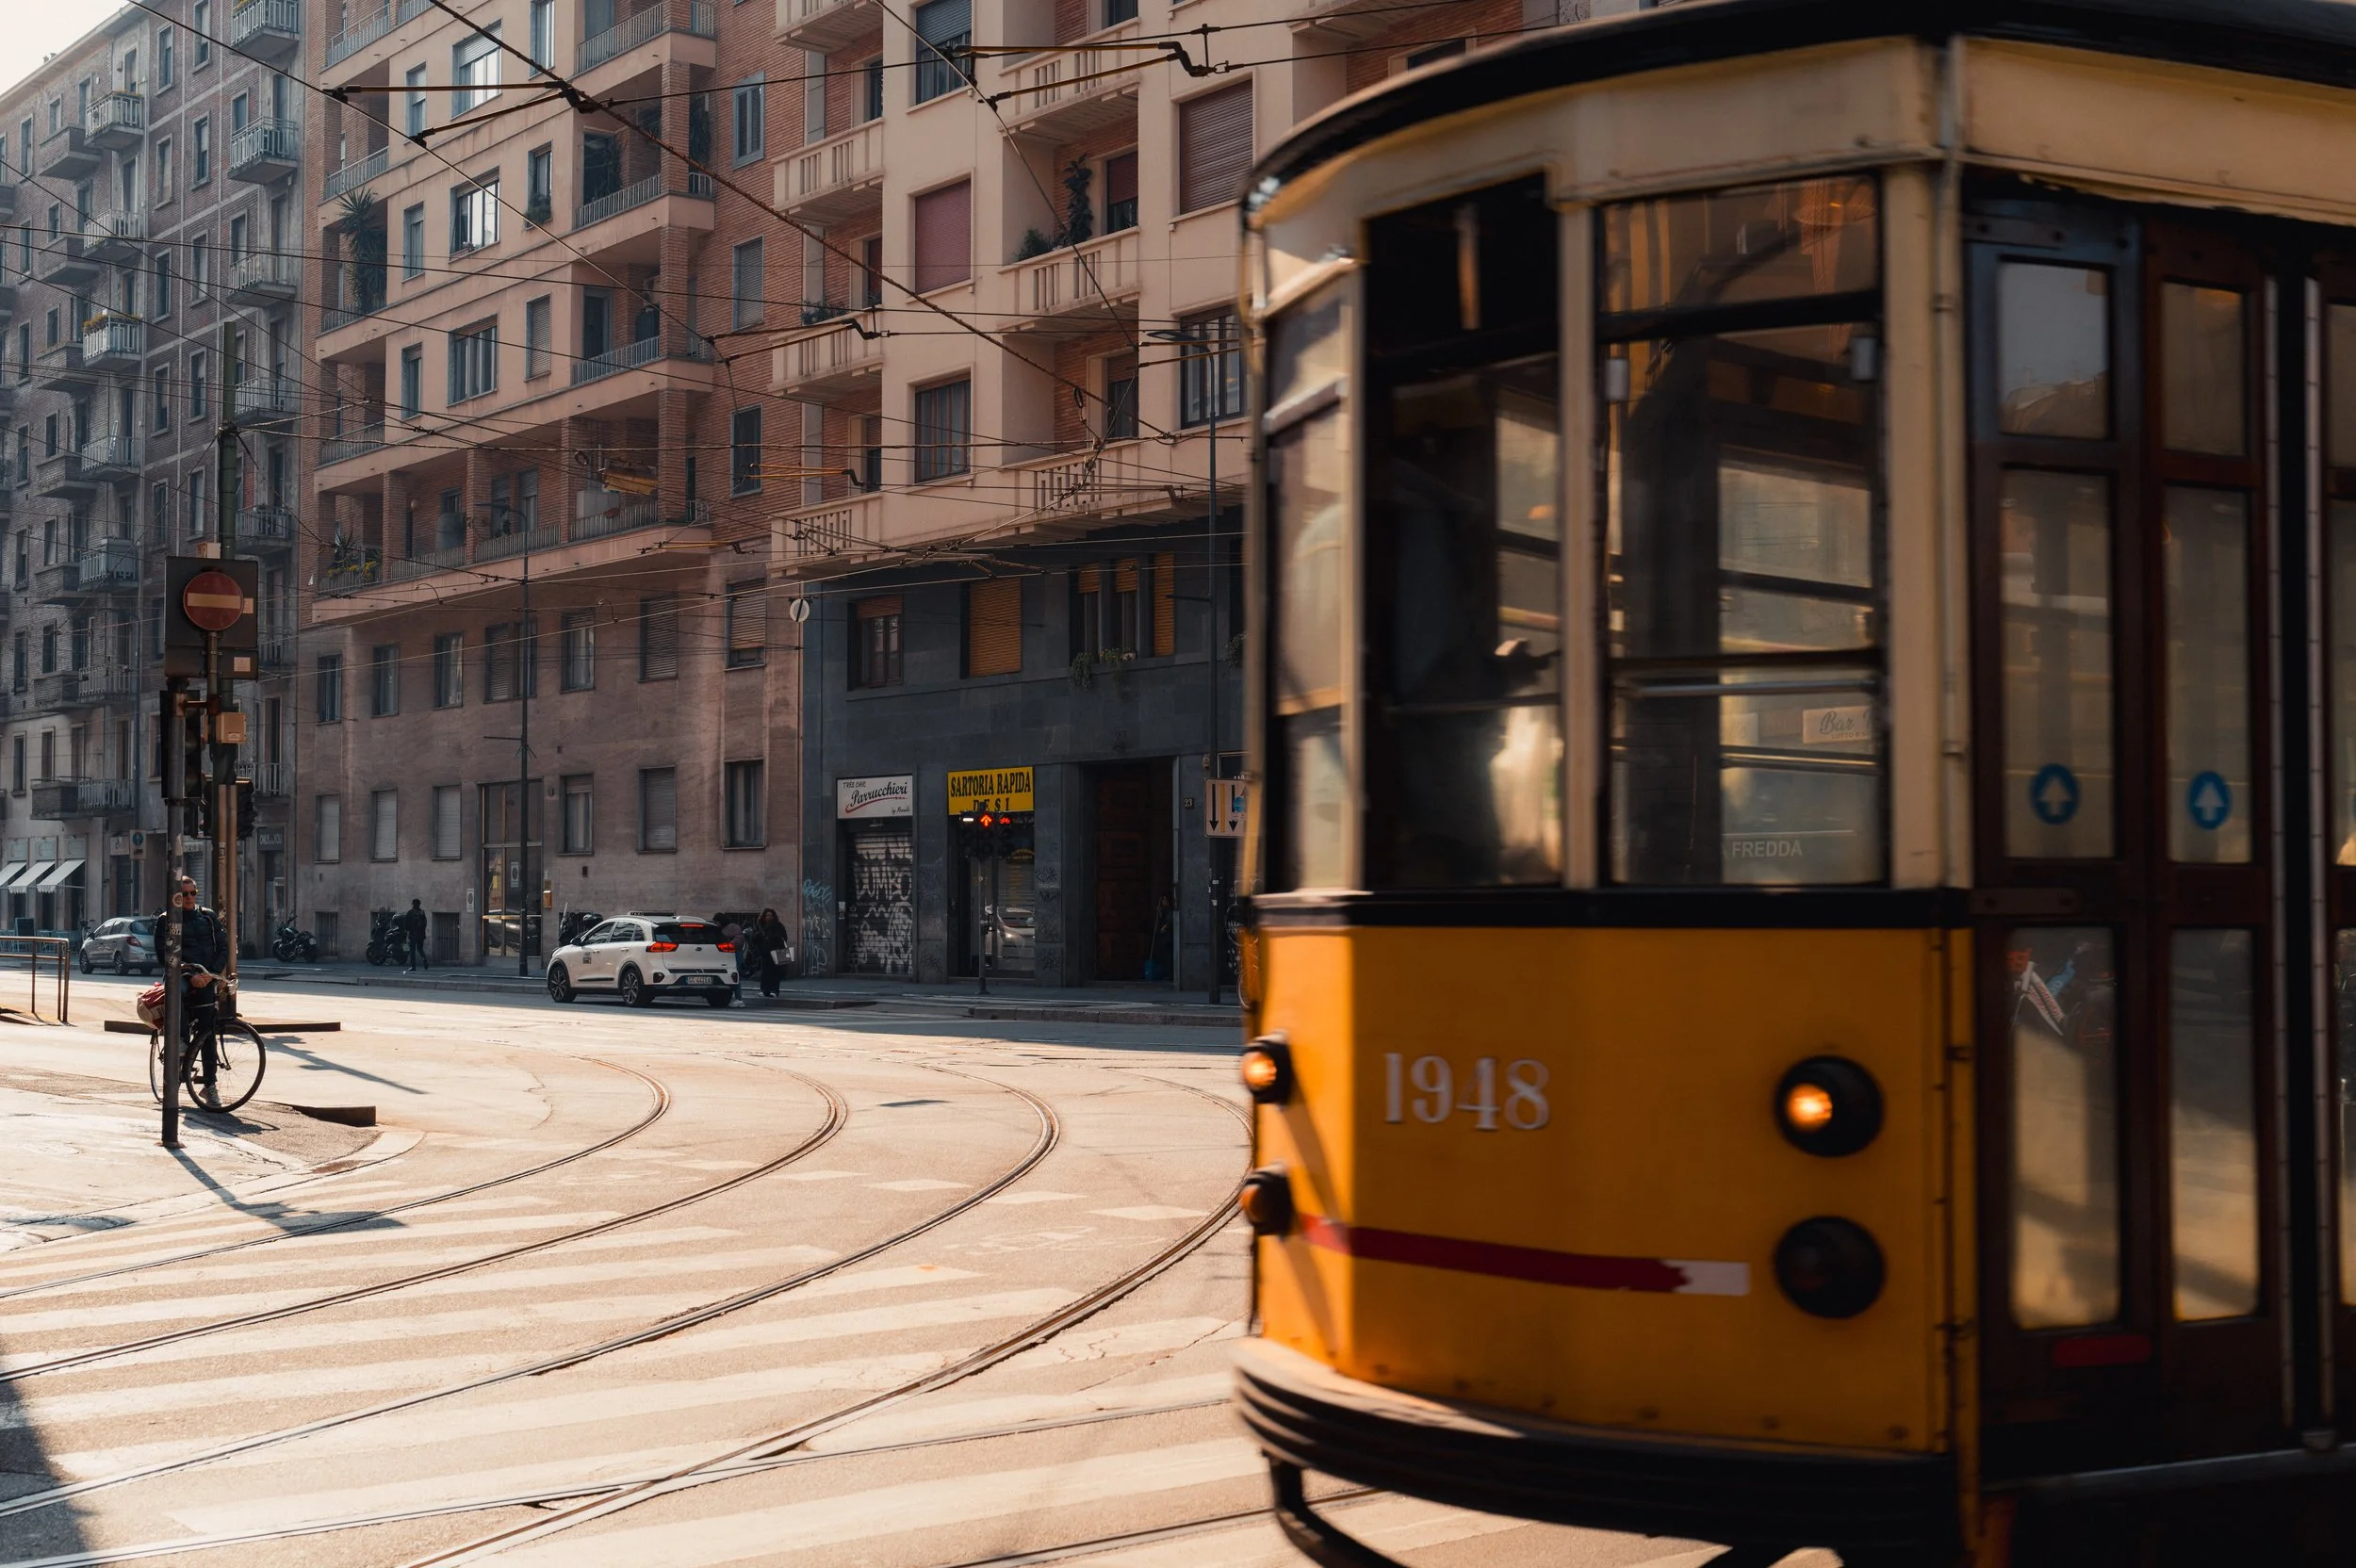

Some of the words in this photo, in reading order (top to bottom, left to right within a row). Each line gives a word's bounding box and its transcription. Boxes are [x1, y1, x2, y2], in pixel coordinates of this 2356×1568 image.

[1819, 710, 1855, 734] Bar
[850, 781, 908, 807] Parrucchieri
[950, 774, 994, 797] SARTORIA
[997, 771, 1031, 794] RAPIDA
[1732, 841, 1803, 858] FREDDA
[1384, 1053, 1550, 1131] 1948
